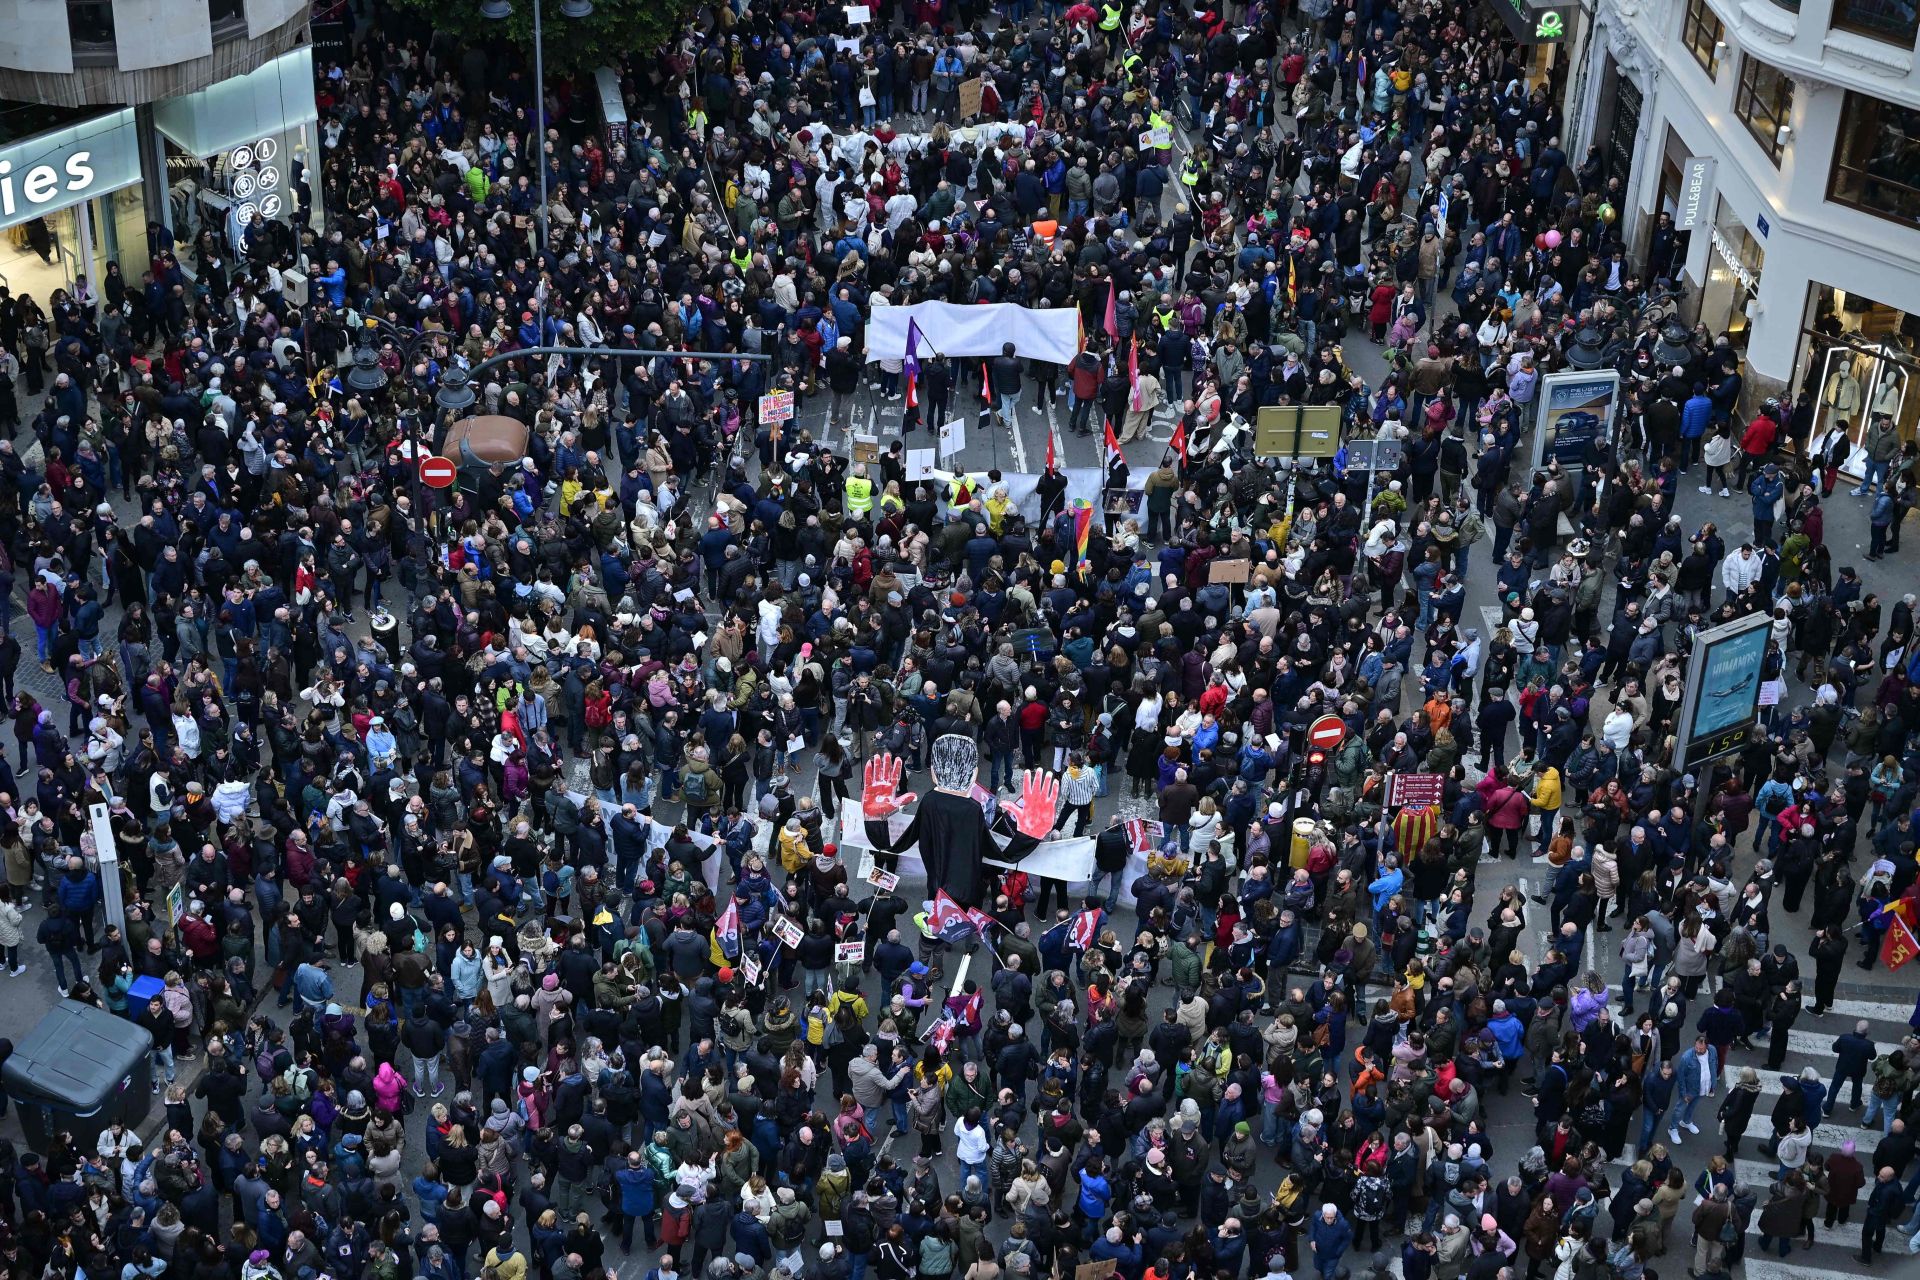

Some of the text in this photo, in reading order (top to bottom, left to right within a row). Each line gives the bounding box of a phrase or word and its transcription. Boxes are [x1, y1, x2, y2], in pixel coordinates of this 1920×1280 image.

[313, 40, 343, 48] lefties
[1685, 163, 1705, 226] PULL&BEAR
[1711, 230, 1748, 289] PULL&BEAR
[1570, 385, 1610, 393] PEUGEOT
[1712, 651, 1757, 677] HUMANOS
